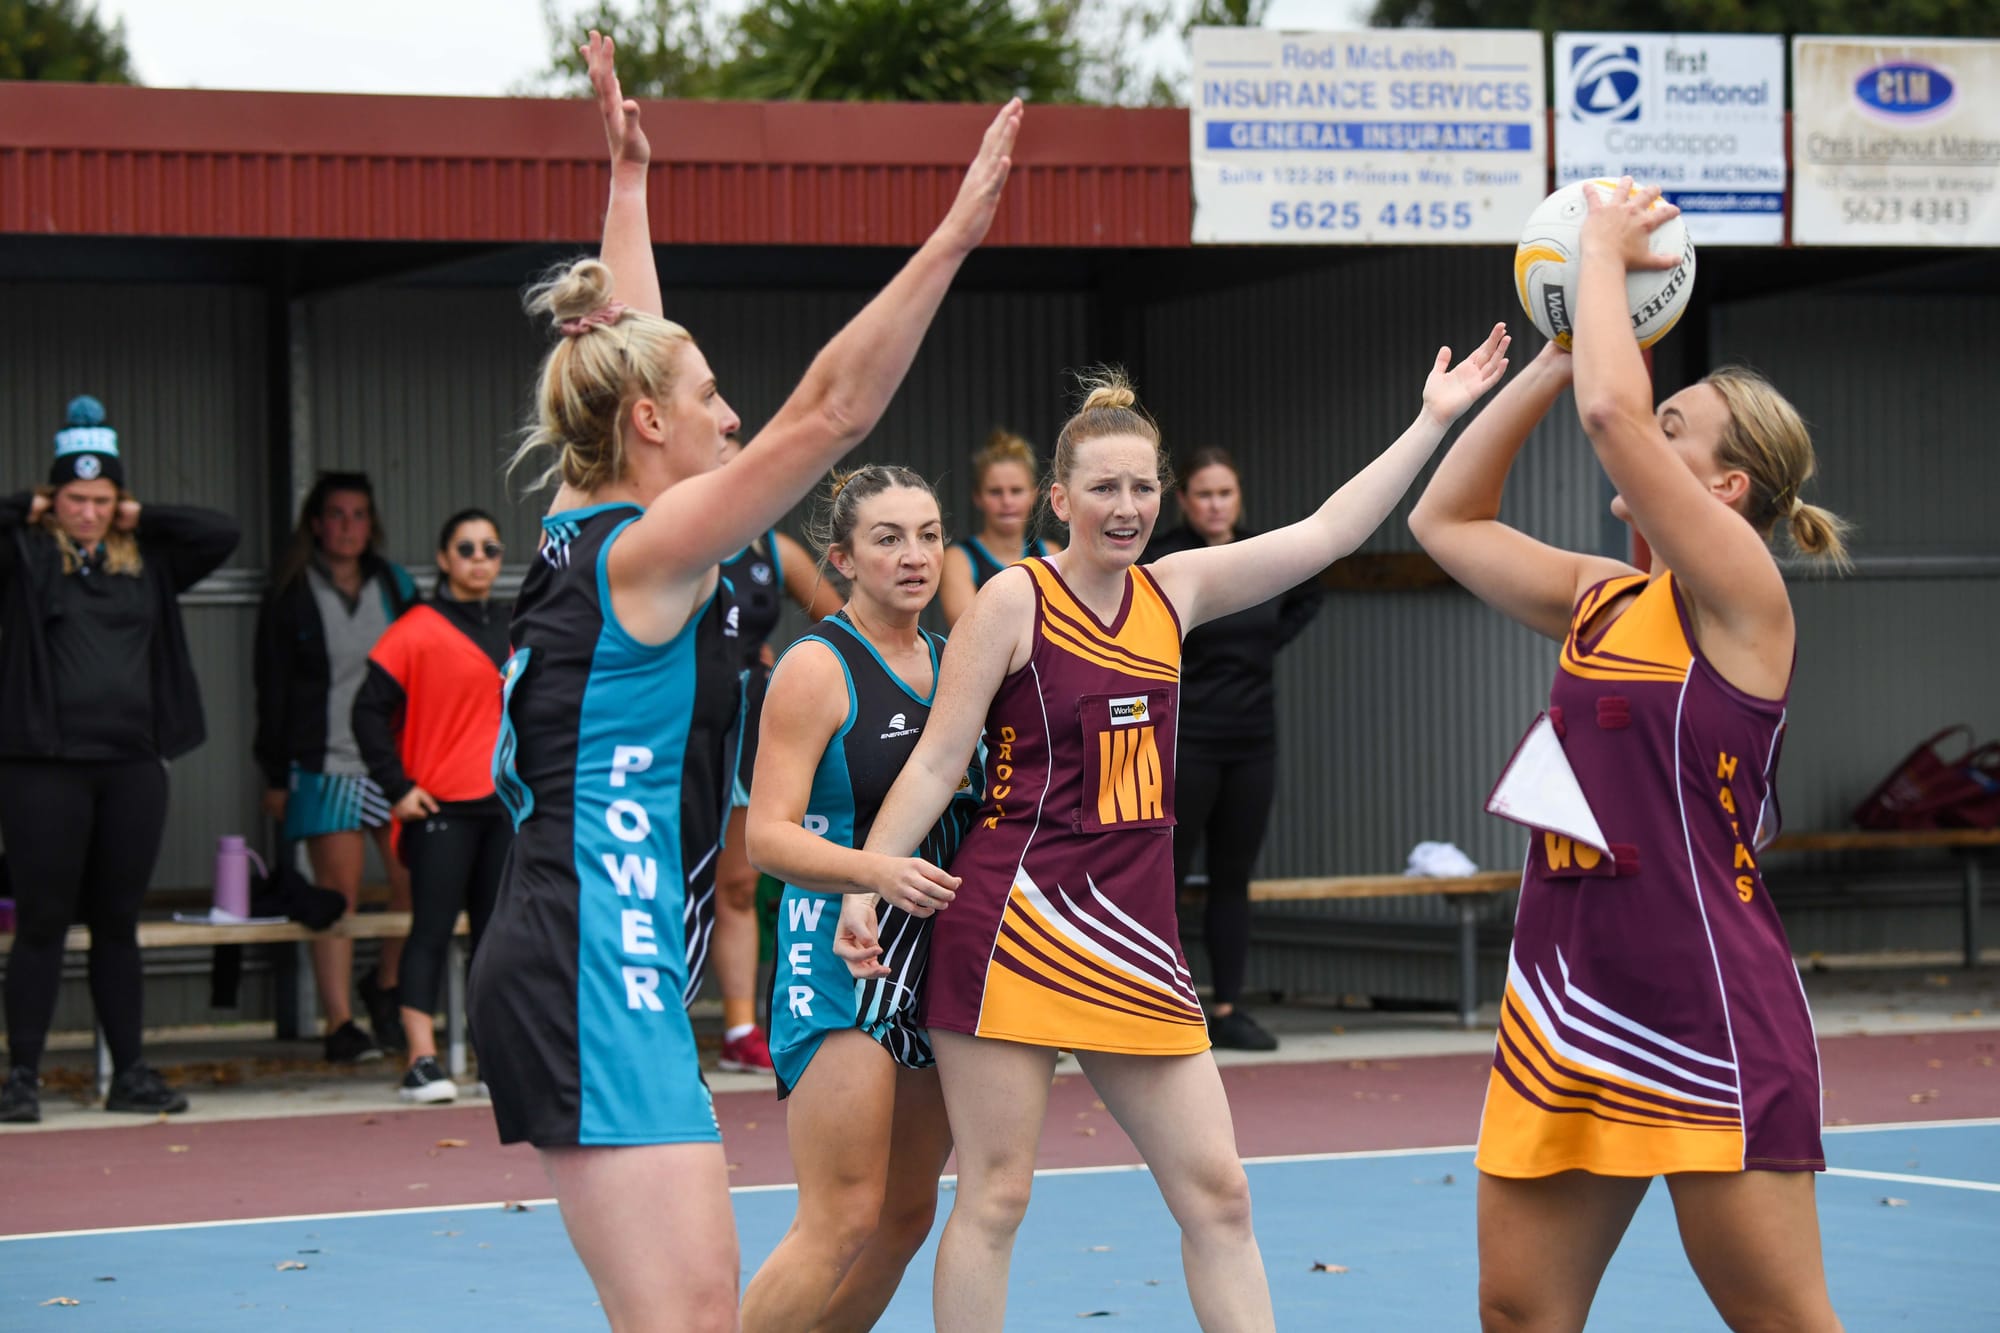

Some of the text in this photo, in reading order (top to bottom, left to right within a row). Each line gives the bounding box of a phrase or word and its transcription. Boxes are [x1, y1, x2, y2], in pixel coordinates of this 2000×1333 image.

[1282, 44, 1456, 71] Rod McLeish
[1665, 49, 1708, 73] first
[1203, 80, 1532, 111] INSURANCE SERVICES
[1665, 80, 1768, 104] national
[1230, 123, 1510, 148] GENERAL INSURANCE
[1605, 128, 1738, 156] Candappa
[1701, 164, 1779, 180] AUCTIONS
[1269, 201, 1473, 229] 5625 4455
[1098, 726, 1164, 825] WA
[601, 745, 665, 1011] POWER
[788, 814, 830, 1019] PWER
